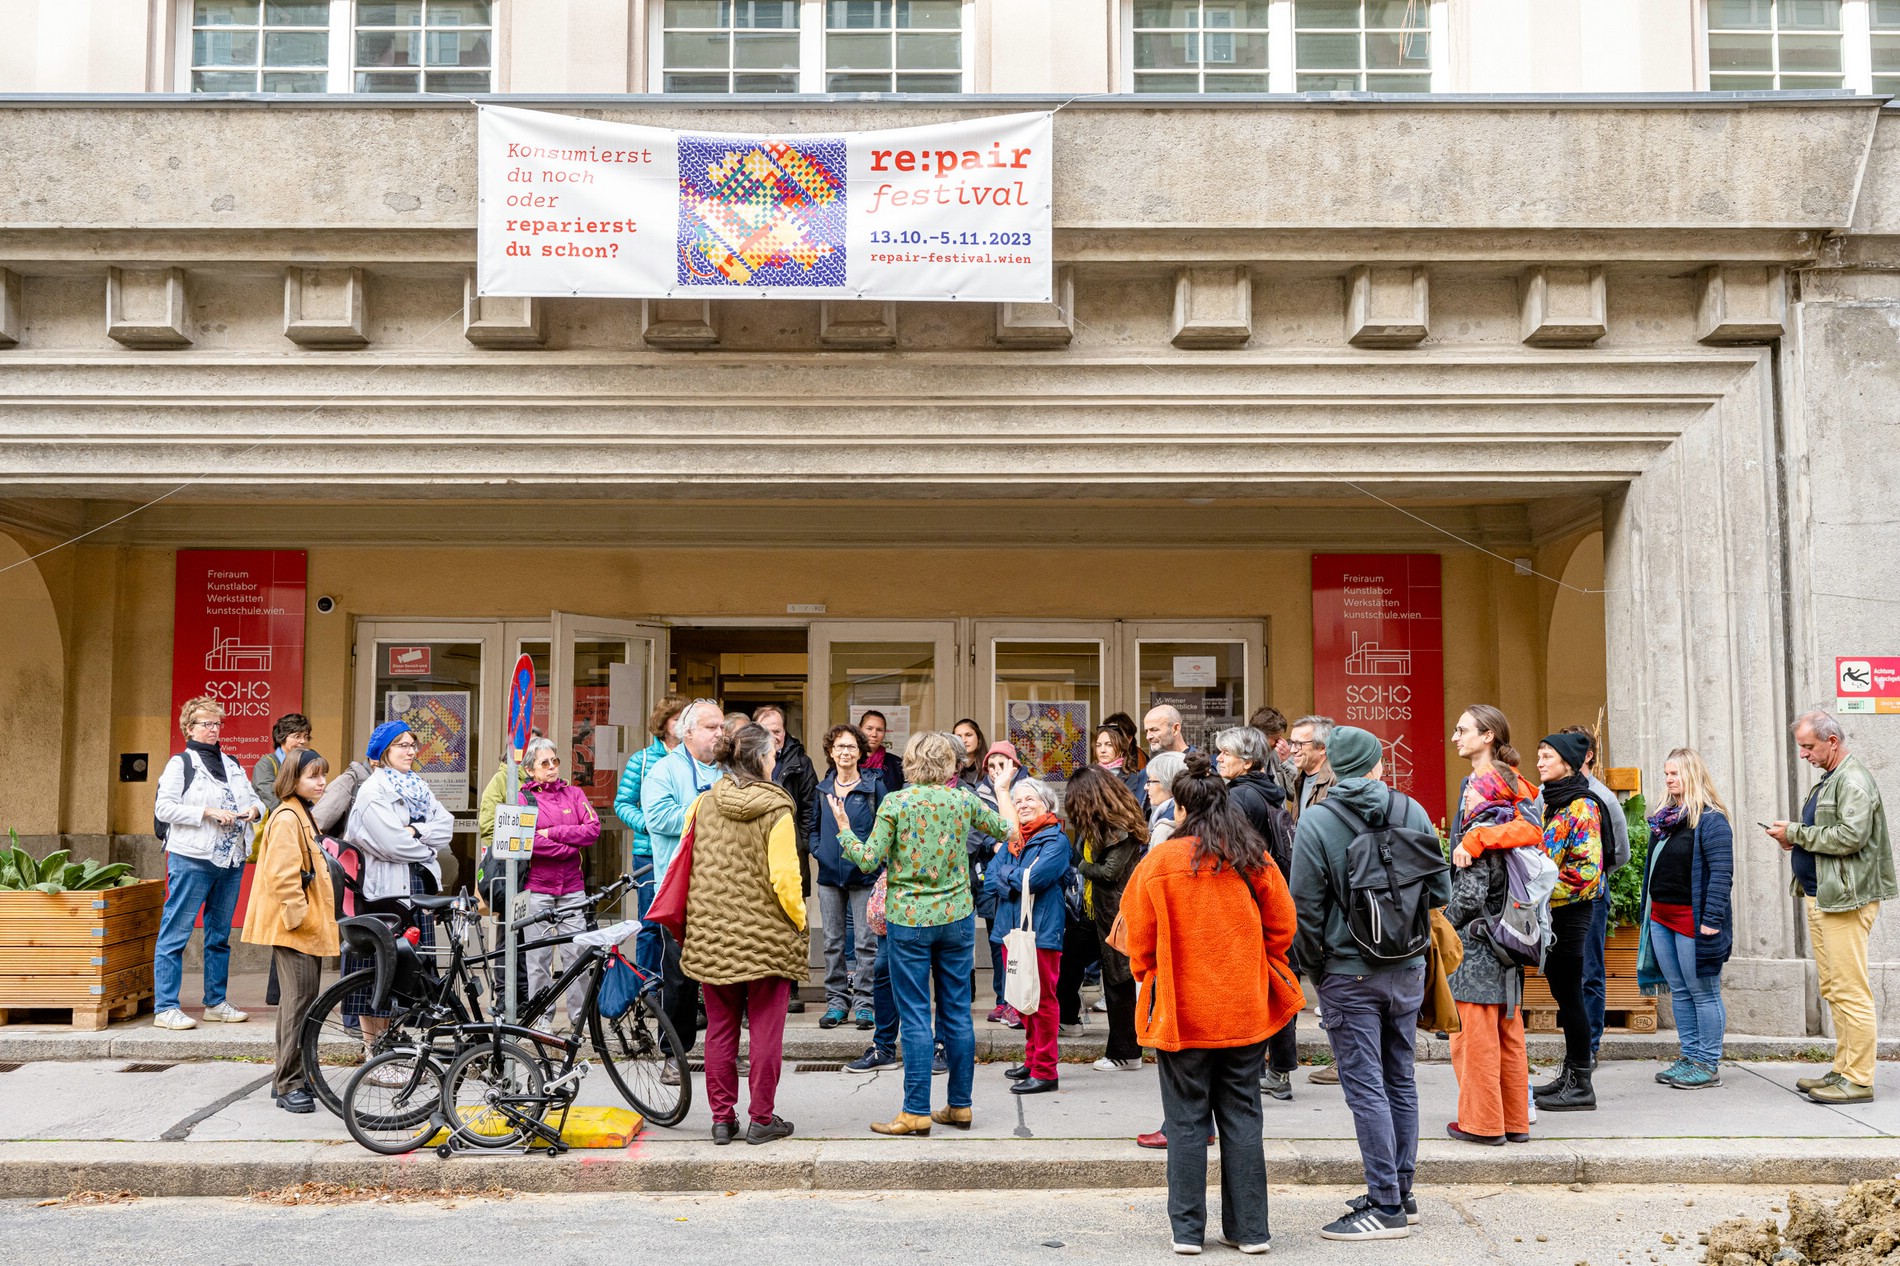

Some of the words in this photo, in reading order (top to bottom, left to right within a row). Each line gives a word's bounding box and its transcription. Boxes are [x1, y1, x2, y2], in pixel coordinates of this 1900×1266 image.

[507, 143, 651, 164] Konsumierst
[871, 142, 1032, 178] re:pair
[508, 168, 532, 182] du
[542, 171, 594, 183] noch
[507, 192, 559, 208] oder
[867, 179, 1029, 213] festival
[506, 217, 637, 235] reparierst
[506, 241, 531, 257] du
[542, 242, 619, 258] schon?
[871, 252, 1031, 264] repair-festival.wien
[208, 570, 249, 579] Freiraum
[1343, 574, 1384, 583] Freiraum
[207, 582, 257, 591] Kunstlabor
[1343, 586, 1393, 595] Kunstlabor
[207, 594, 264, 603] Werkstätten
[1343, 598, 1400, 607] Werkstätten
[206, 606, 285, 615] kunstschule.wien
[1343, 610, 1422, 619] kunstschule.wien
[205, 681, 271, 699] SOHO
[1346, 685, 1412, 703] SOHO
[218, 702, 270, 717] UDIOS
[1346, 706, 1412, 720] STUDIOS
[498, 812, 510, 828] gilt
[511, 814, 520, 826] ab
[496, 840, 508, 850] von
[514, 900, 527, 921] Ende
[1636, 1018, 1649, 1026] EPAL
